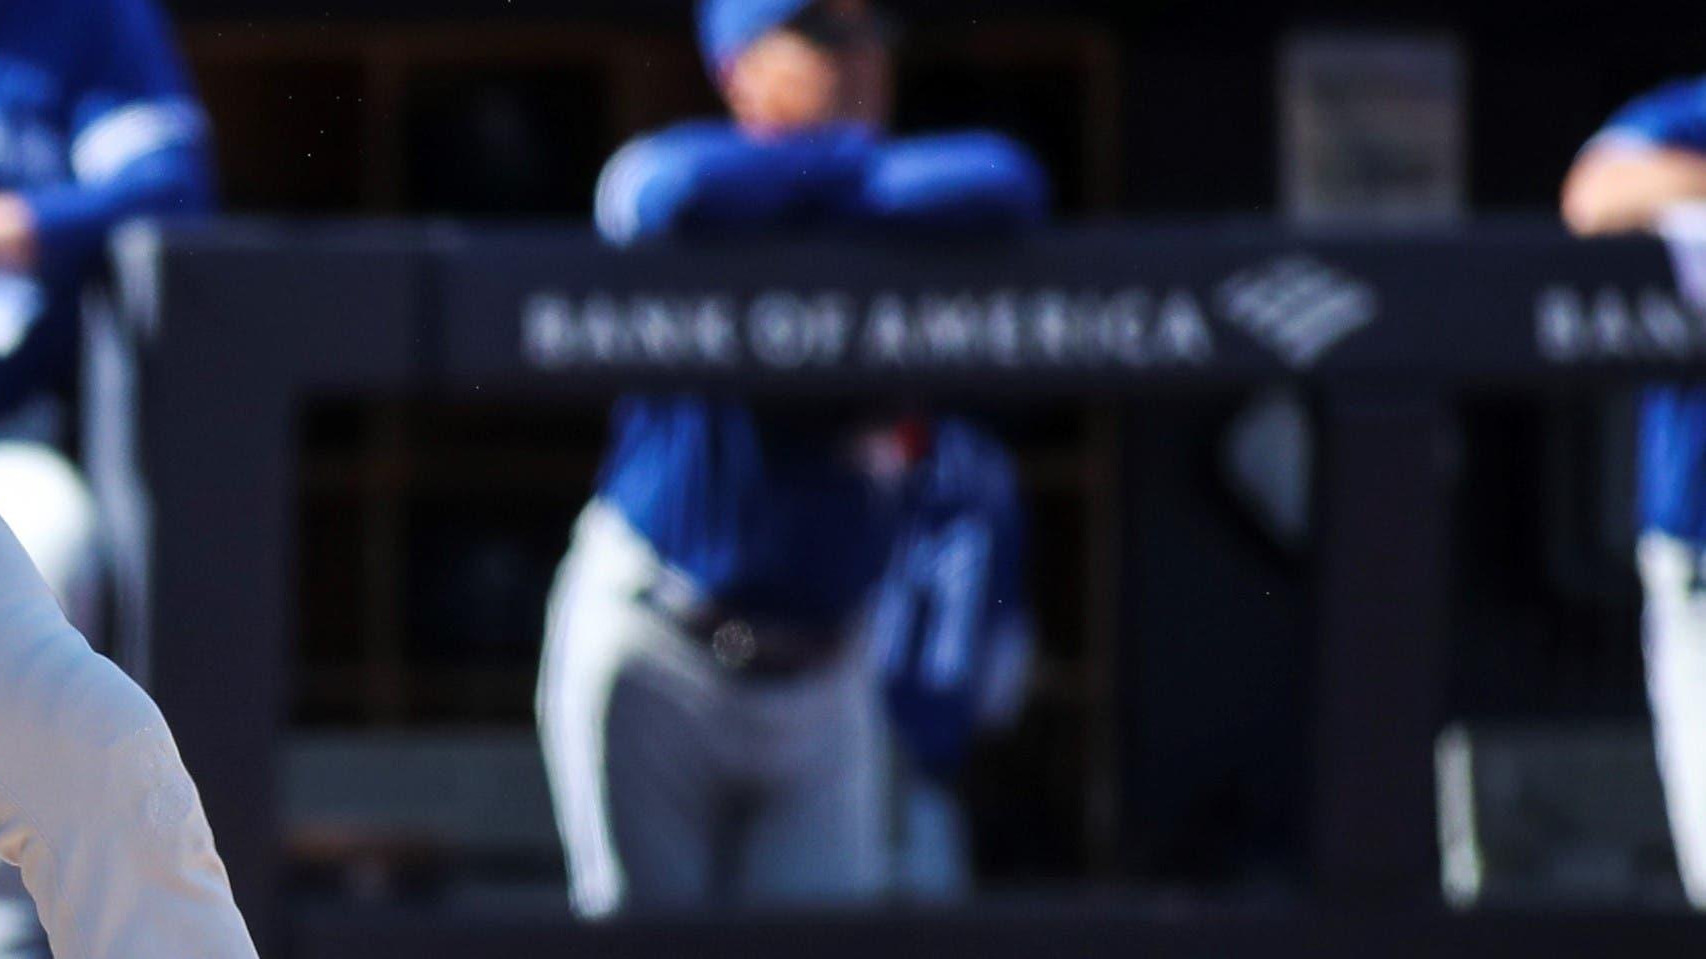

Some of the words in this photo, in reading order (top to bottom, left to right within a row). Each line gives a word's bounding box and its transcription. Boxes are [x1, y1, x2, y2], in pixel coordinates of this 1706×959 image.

[522, 290, 738, 365] BANK
[745, 289, 851, 367] OF
[864, 290, 1214, 366] AMERICA
[1535, 288, 1698, 360] BAN
